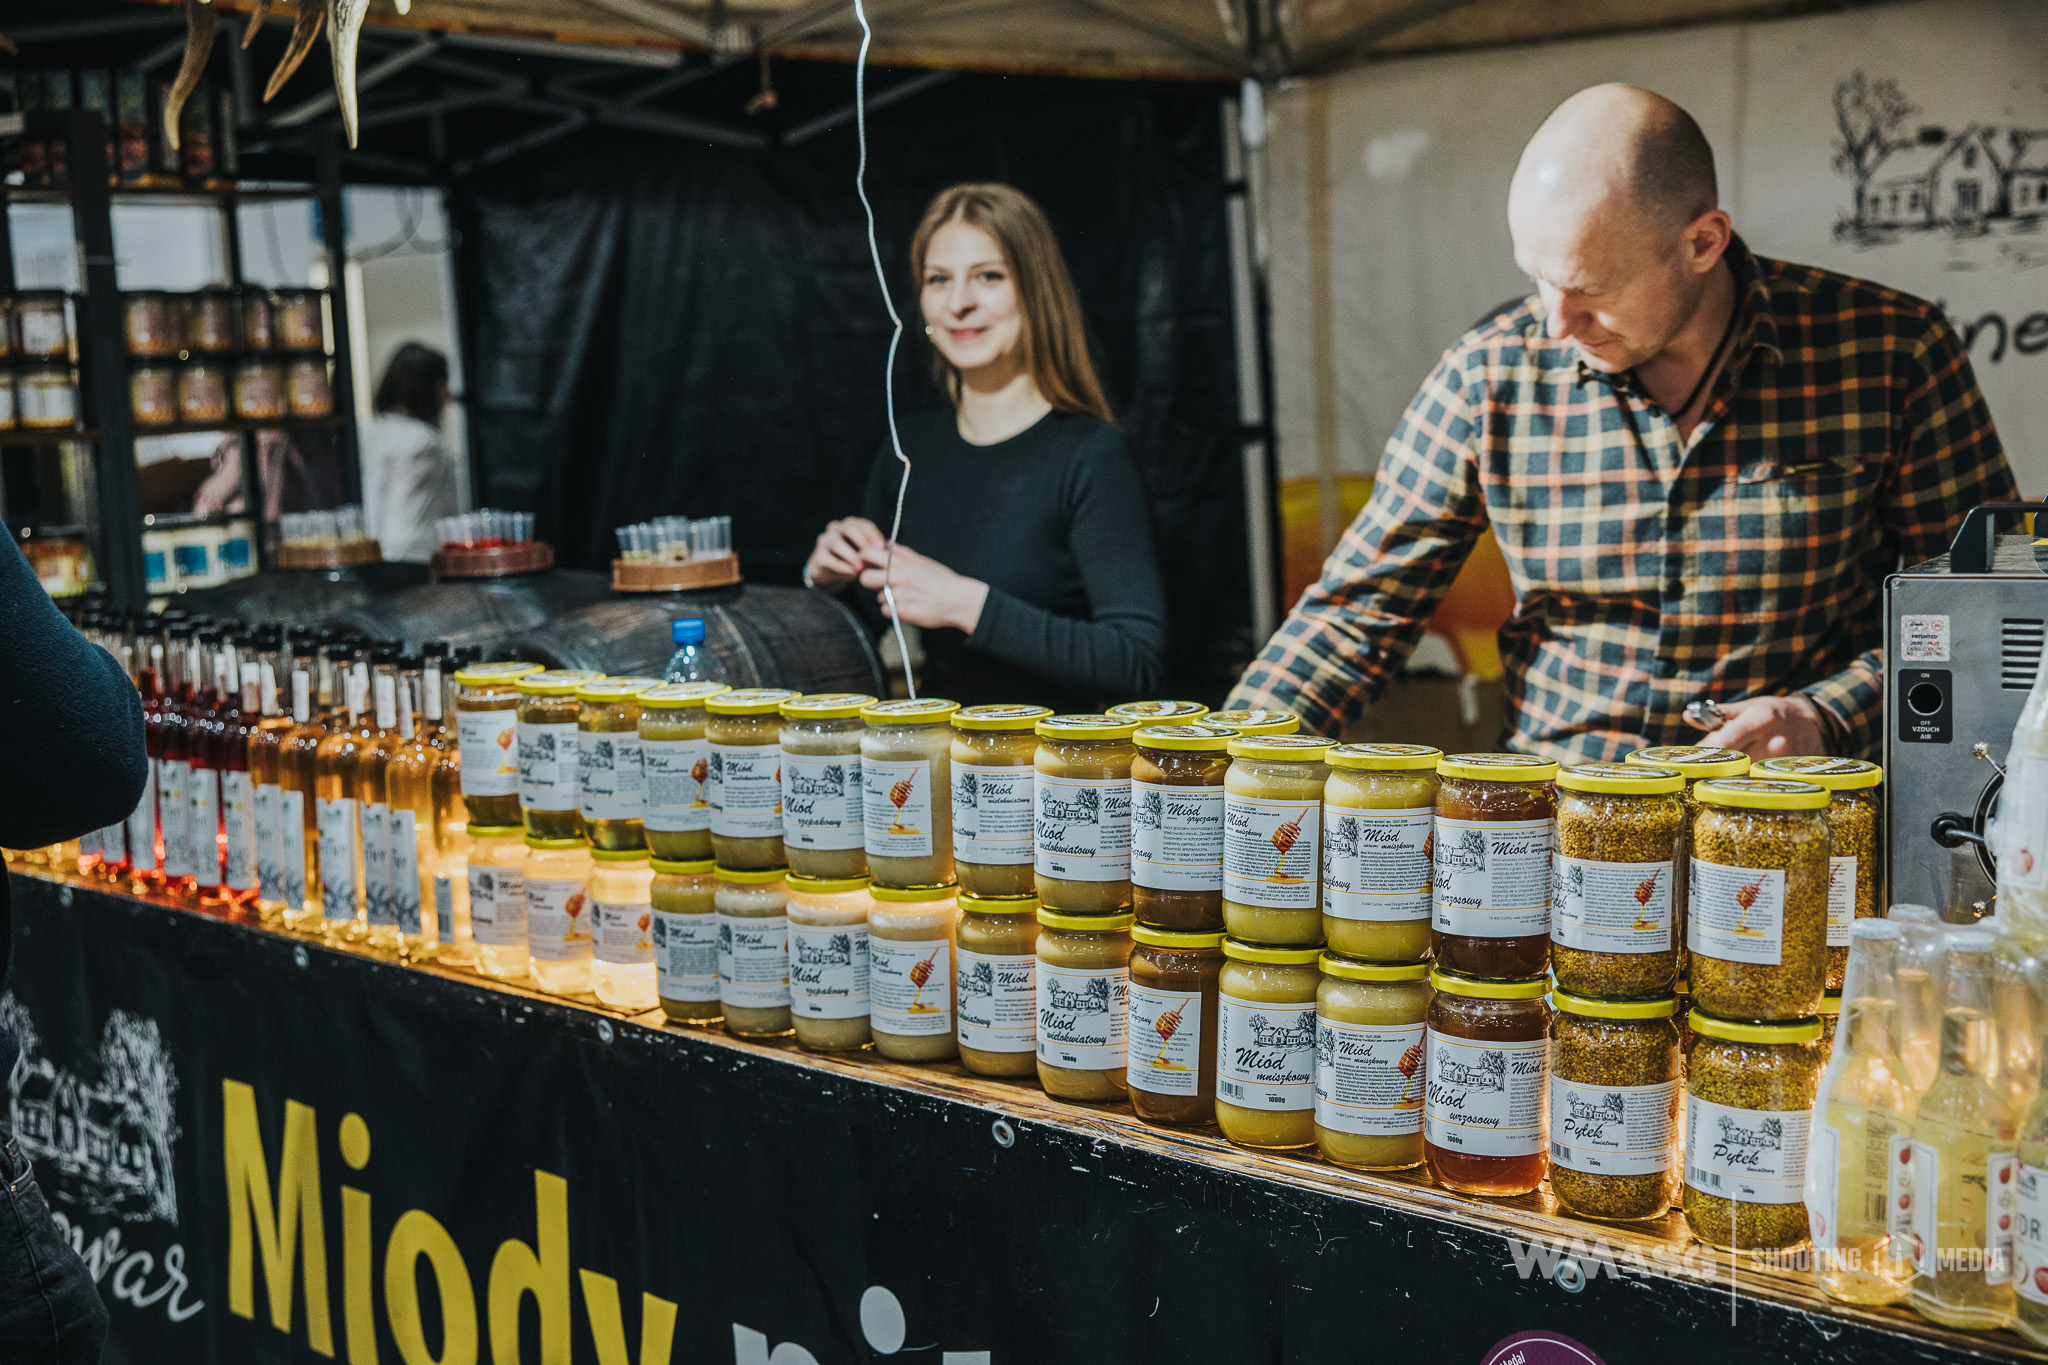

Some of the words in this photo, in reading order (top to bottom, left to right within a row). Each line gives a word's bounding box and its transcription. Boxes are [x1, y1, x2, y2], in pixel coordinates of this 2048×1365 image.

[981, 783, 1014, 795] Miód
[783, 795, 815, 815] Miód
[1103, 797, 1132, 810] Miód
[1166, 803, 1202, 816] Miód
[1186, 816, 1220, 825] gryczany
[1227, 812, 1250, 828] Miód
[1035, 818, 1067, 842] Miód
[1363, 828, 1400, 842] Miód
[1039, 841, 1097, 858] wielokwiatowy
[1381, 842, 1415, 852] mniszkowy
[1491, 841, 1530, 856] Miód
[1440, 895, 1483, 909] wrzosowy
[790, 963, 822, 985] Miód
[997, 972, 1030, 984] Miód
[1039, 1008, 1077, 1032] Miód
[1046, 1030, 1107, 1047] wielokwiatowy
[1338, 1041, 1374, 1056] Miód
[1235, 1047, 1287, 1071] Miód
[1353, 1057, 1389, 1066] mniszkowy
[1511, 1060, 1542, 1075] Miód
[1256, 1070, 1311, 1085] mniszkowy
[1268, 1096, 1286, 1104] 1000g
[1428, 1080, 1467, 1109] Miód
[1449, 1112, 1500, 1129] wrzosowy
[1446, 1135, 1463, 1145] 1000g
